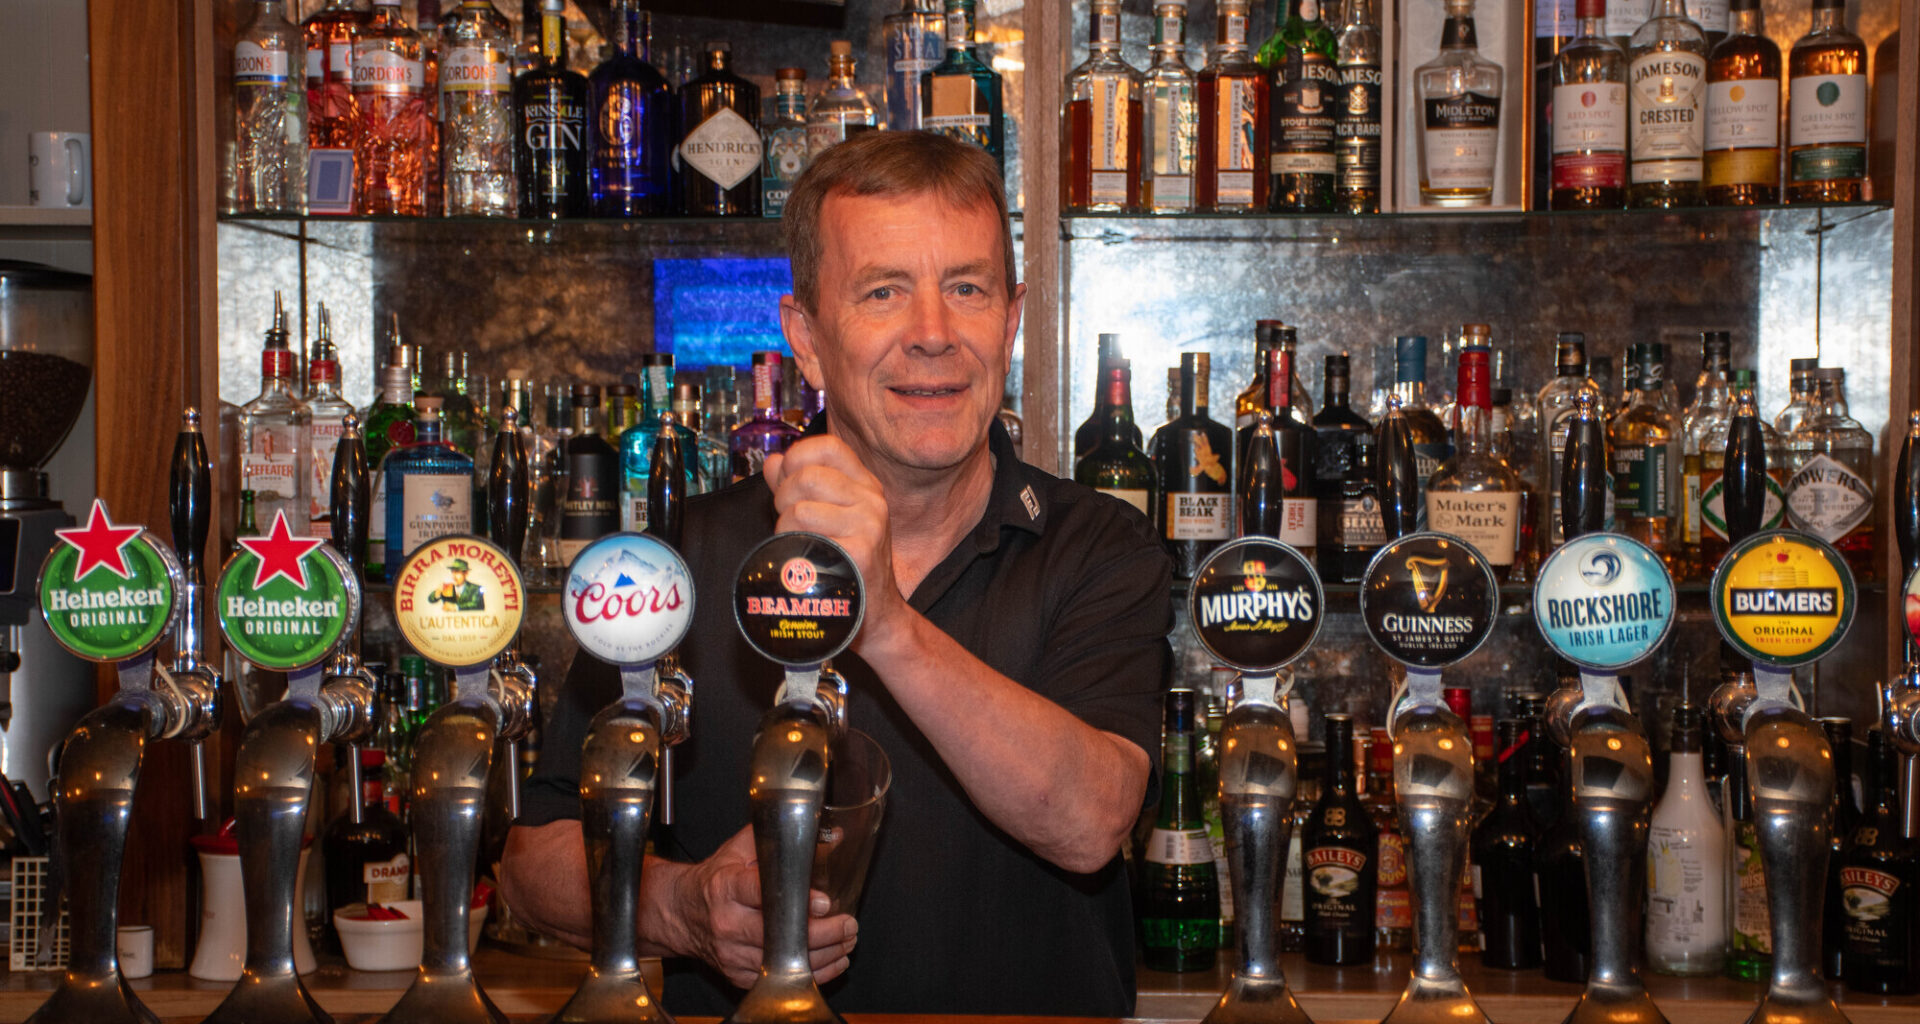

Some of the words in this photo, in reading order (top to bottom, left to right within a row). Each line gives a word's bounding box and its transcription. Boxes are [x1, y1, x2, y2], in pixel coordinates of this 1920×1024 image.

[353, 66, 412, 82] GORDON'S
[1634, 61, 1700, 84] JAMESON
[525, 104, 584, 120] KINSALE
[1436, 104, 1496, 119] MIDLETON
[1588, 110, 1612, 120] SPOT
[1746, 104, 1769, 113] SPOT
[1640, 109, 1695, 125] CRESTED
[1801, 113, 1833, 123] GREEN
[1835, 112, 1856, 121] SPOT
[525, 124, 583, 151] GIN
[1730, 124, 1744, 136] 12
[312, 424, 344, 437] FEATER
[243, 464, 294, 478] BEEFEATER
[1791, 468, 1858, 491] POWERS
[1179, 496, 1219, 507] BLACK
[1436, 499, 1507, 512] Maker's
[408, 521, 470, 530] GUNPOWDER
[1455, 514, 1506, 528] Mark
[400, 548, 444, 613] BIRRA
[447, 543, 519, 611] MORETTI
[50, 586, 164, 612] Heineken
[226, 596, 339, 618] Heineken
[571, 582, 684, 624] Coors
[747, 596, 851, 617] BEAMISH
[1201, 585, 1313, 628] MURPHY'S
[1735, 591, 1833, 612] BULMERS
[1547, 588, 1664, 630] ROCKSHORE
[69, 610, 147, 628] ORIGINAL
[419, 615, 500, 630] L'AUTENTICA
[778, 618, 819, 632] Genuine
[1382, 612, 1473, 634] GUINNESS
[245, 620, 321, 635] ORIGINAL
[770, 629, 794, 639] IRISH
[797, 629, 825, 639] STOUT
[1753, 626, 1815, 636] ORIGINAL
[1444, 634, 1465, 643] GATE
[1569, 629, 1603, 648] IRISH
[1609, 624, 1650, 644] LAGER
[1307, 849, 1362, 866] BAILEYS
[1842, 870, 1893, 890] AILEYS
